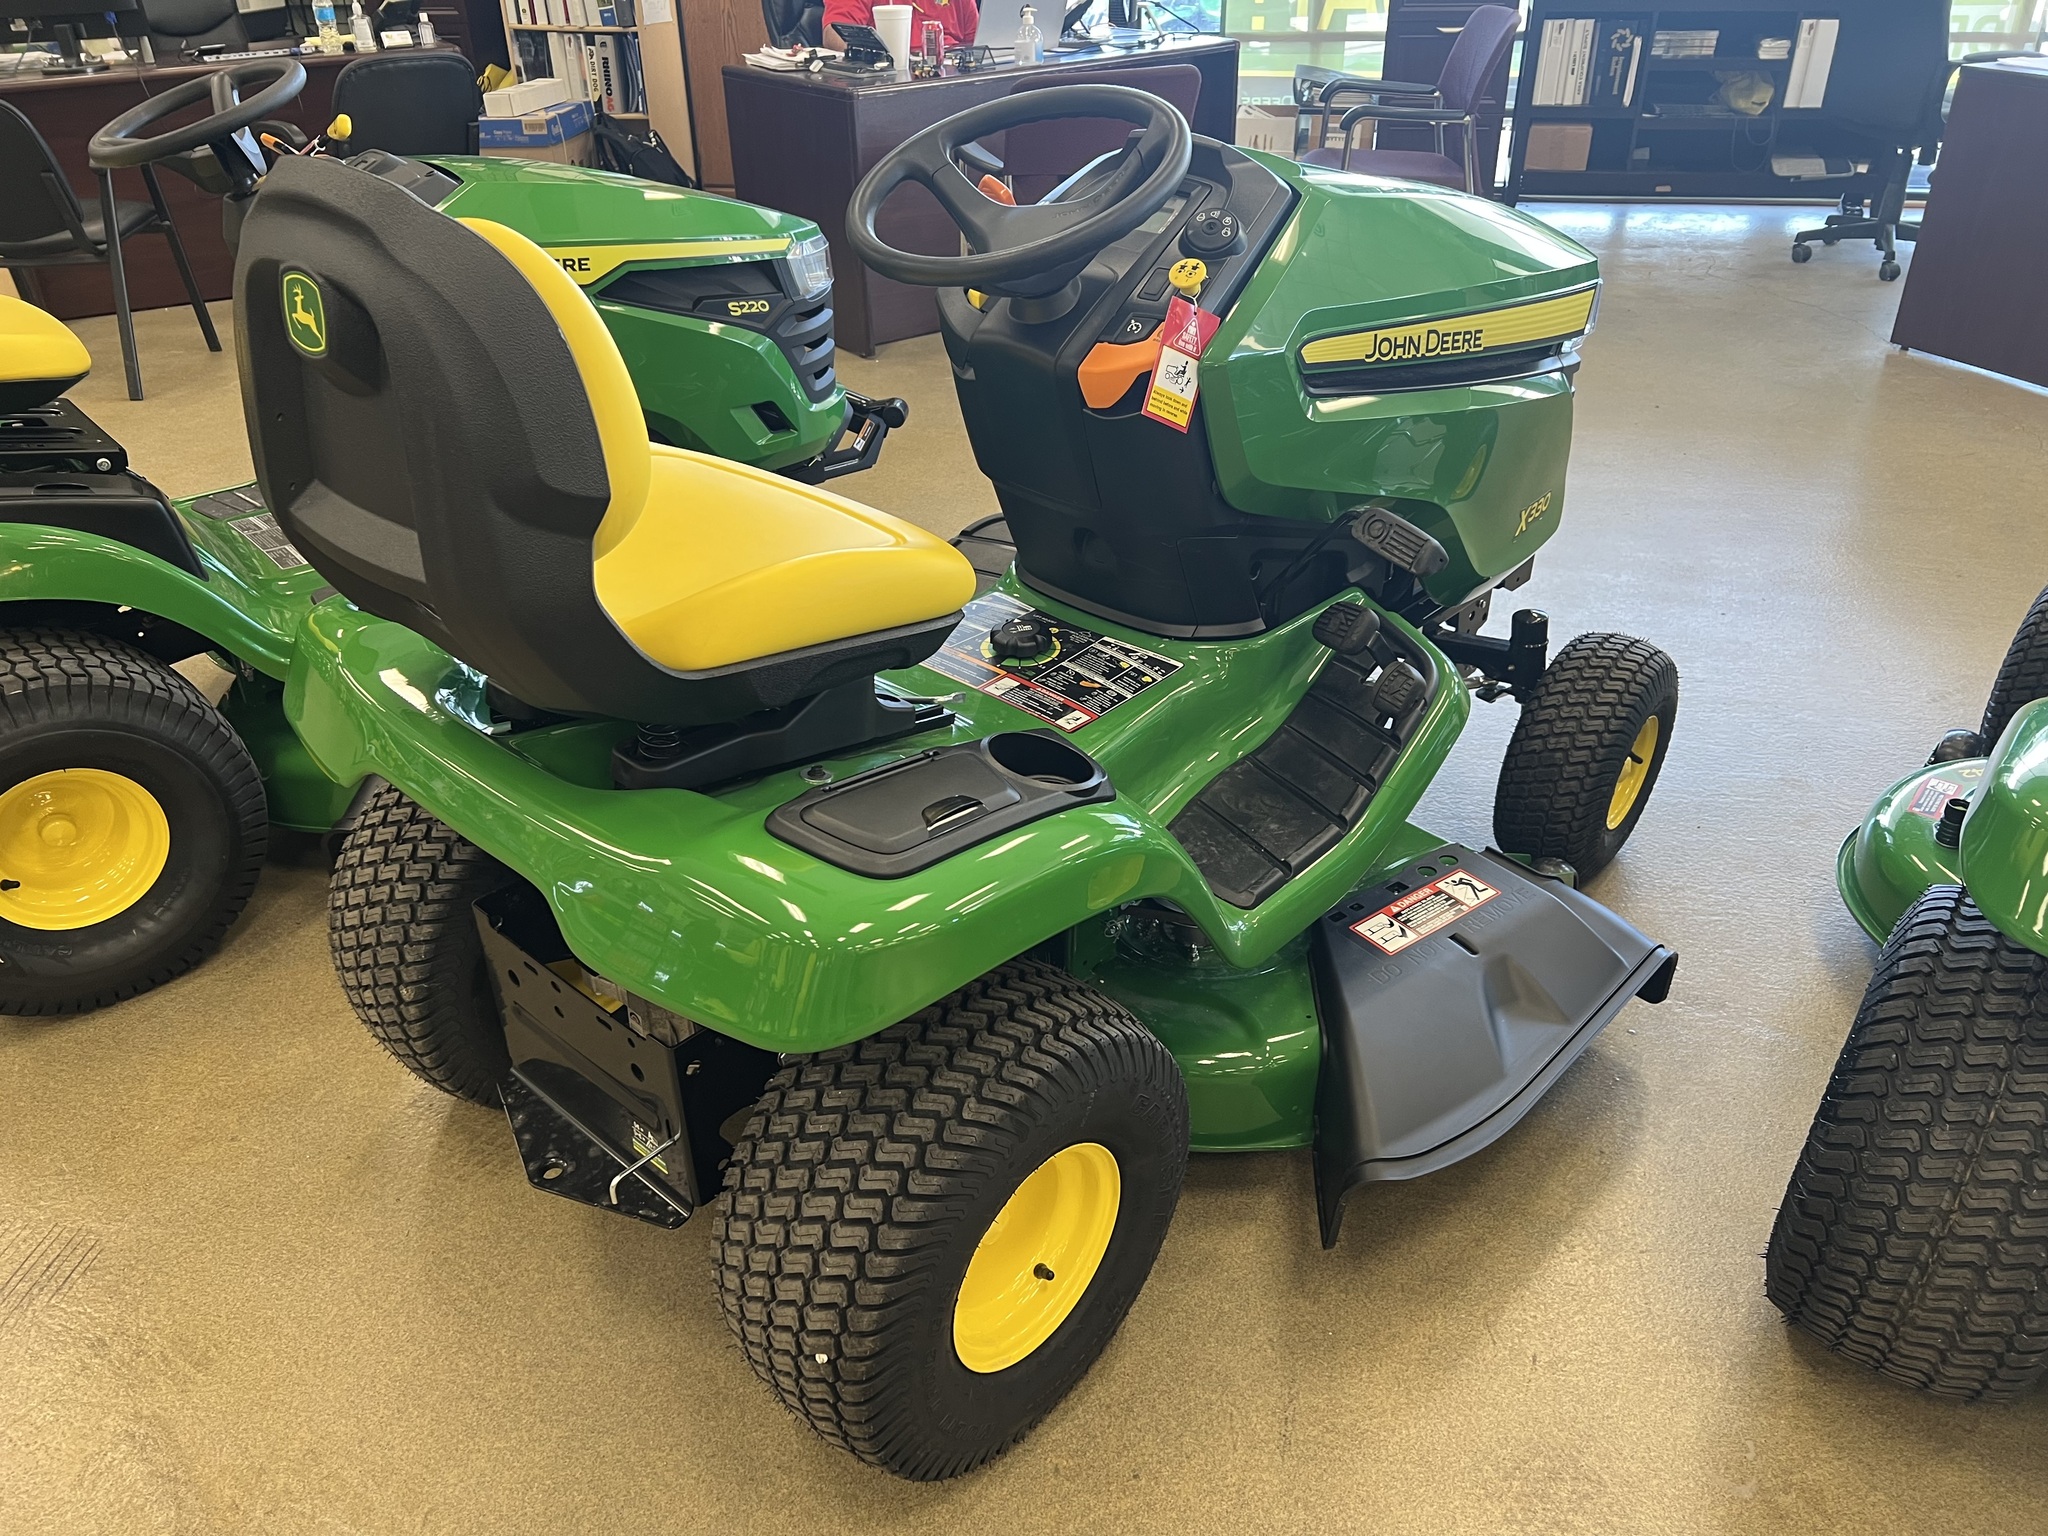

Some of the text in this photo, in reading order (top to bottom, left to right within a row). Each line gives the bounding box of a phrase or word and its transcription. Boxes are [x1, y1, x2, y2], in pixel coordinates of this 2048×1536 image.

[590, 61, 598, 77] DIRT
[602, 57, 615, 112] RHINOAG
[728, 300, 769, 316] S220
[1365, 328, 1484, 360] JOHN DEERE
[1514, 492, 1551, 537] X330
[1396, 888, 1434, 908] DANGER
[1368, 961, 1403, 985] DO
[1403, 938, 1447, 966] NOT
[1459, 886, 1536, 934] REMOVE
